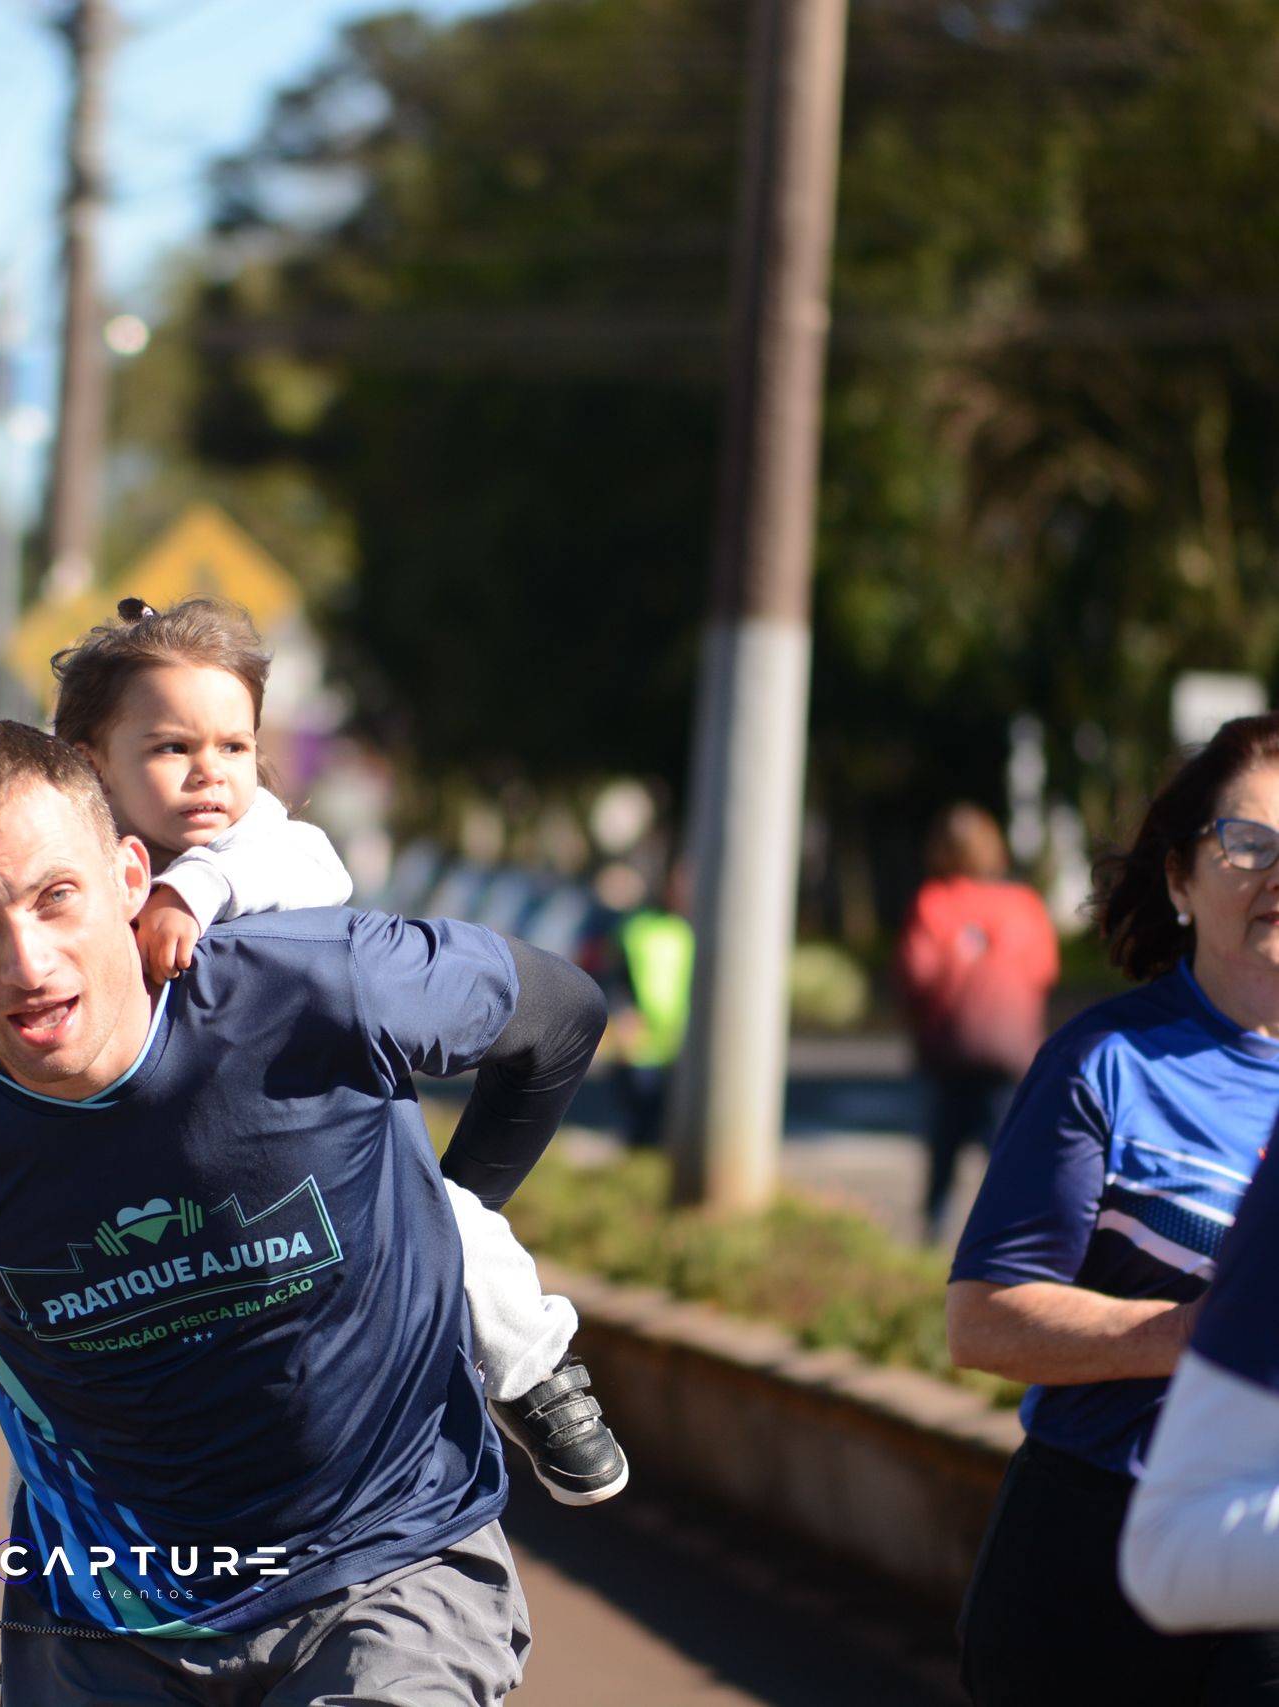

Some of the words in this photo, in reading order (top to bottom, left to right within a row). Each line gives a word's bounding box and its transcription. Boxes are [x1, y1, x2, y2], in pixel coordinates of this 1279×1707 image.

[42, 1257, 196, 1324] PRATIQUE
[201, 1232, 313, 1277] AJUDA
[68, 1325, 168, 1352] EDUCAÇÃO
[171, 1306, 233, 1334] FÍSICA
[235, 1300, 261, 1318] EM
[263, 1278, 314, 1307] AÇÃO
